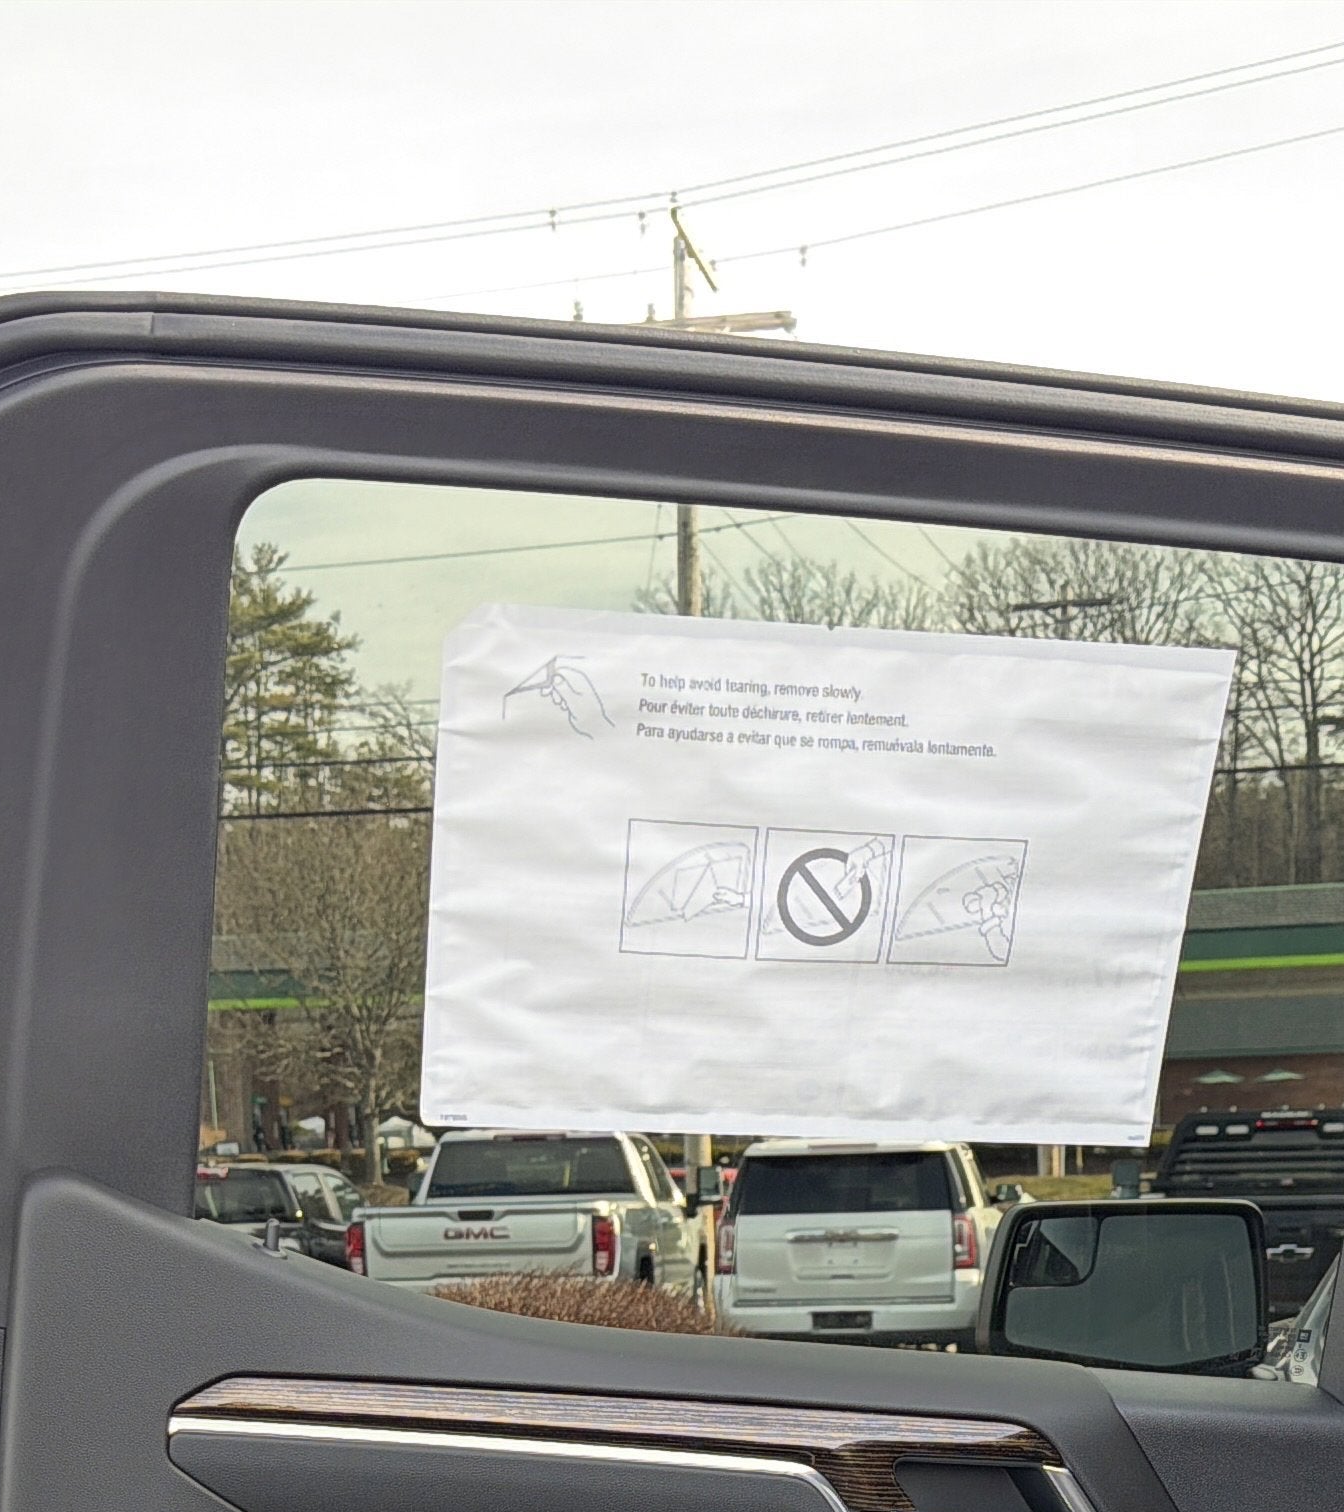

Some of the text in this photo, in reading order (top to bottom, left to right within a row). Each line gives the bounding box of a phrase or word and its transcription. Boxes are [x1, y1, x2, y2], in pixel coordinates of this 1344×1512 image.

[640, 673, 656, 687] To
[659, 674, 686, 691] help
[689, 677, 722, 692] avoid
[725, 678, 772, 697] tearing,
[774, 682, 820, 697] remove
[638, 698, 909, 727] Pour éviter toute déchirure, retirer lentement.
[636, 722, 997, 757] Para ayudarse a evitar que se rompa, remuévala lentamente.
[444, 1226, 511, 1240] GMC
